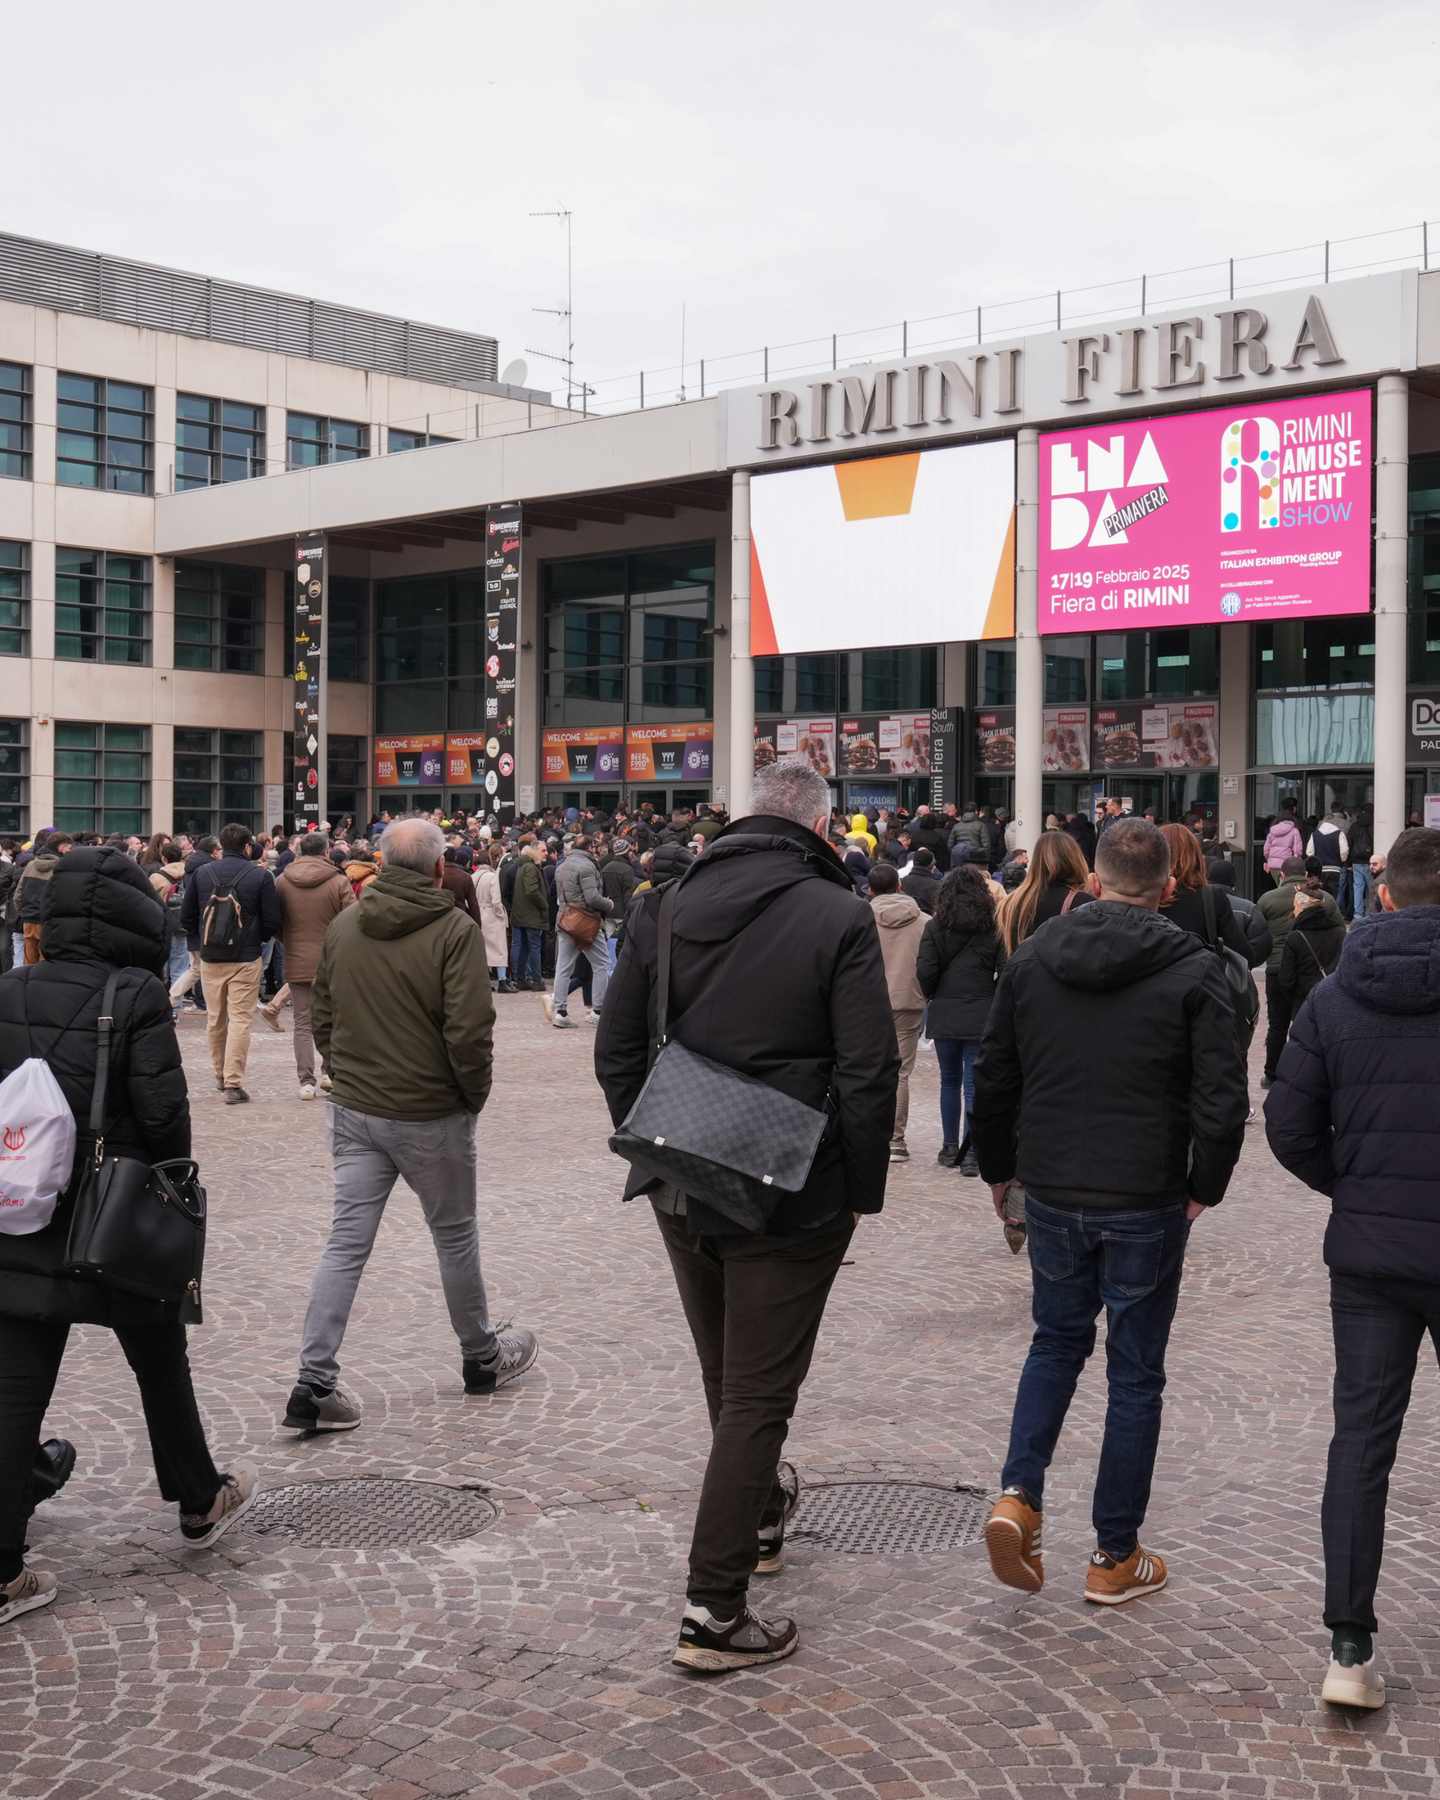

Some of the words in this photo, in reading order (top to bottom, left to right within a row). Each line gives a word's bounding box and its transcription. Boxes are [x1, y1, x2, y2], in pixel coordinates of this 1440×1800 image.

[757, 348, 1022, 450] RIMINI
[1060, 294, 1346, 404] FIERA
[1283, 412, 1351, 445] RIMINI
[1282, 440, 1361, 474] AMUSE
[1283, 472, 1346, 504] MENT
[1104, 485, 1169, 537] PRIMAVERA
[1282, 502, 1352, 527] SHOW
[1220, 558, 1254, 569] ITALIAN
[1255, 554, 1307, 566] EXHIBITION
[1308, 551, 1342, 562] GROUP
[1096, 568, 1150, 584] Febbraio
[1153, 564, 1190, 580] 2025
[1051, 594, 1096, 614] Fiera
[1101, 590, 1118, 609] di
[1124, 584, 1190, 609] RIMINI
[931, 709, 947, 720] Sud
[1098, 712, 1115, 720] BURGER
[1185, 707, 1213, 716] FINGERFOOD
[630, 729, 667, 738] WELCOME
[810, 723, 832, 731] FINGERFOOD
[931, 721, 954, 733] South
[979, 731, 993, 739] SMASH
[999, 726, 1014, 735] BABY!
[1097, 726, 1114, 736] SMASH
[1120, 722, 1136, 732] BABY!
[378, 740, 408, 748] WELCOME
[451, 737, 482, 746] WELCOME
[547, 733, 581, 742] WELCOME
[760, 735, 773, 743] BABY!
[842, 734, 857, 744] SMASH
[857, 733, 861, 741] IT
[861, 731, 875, 741] BABY!
[930, 738, 944, 772] Fiera
[849, 796, 867, 805] ZERO
[868, 796, 897, 805] CALORIE
[930, 776, 943, 814] imini
